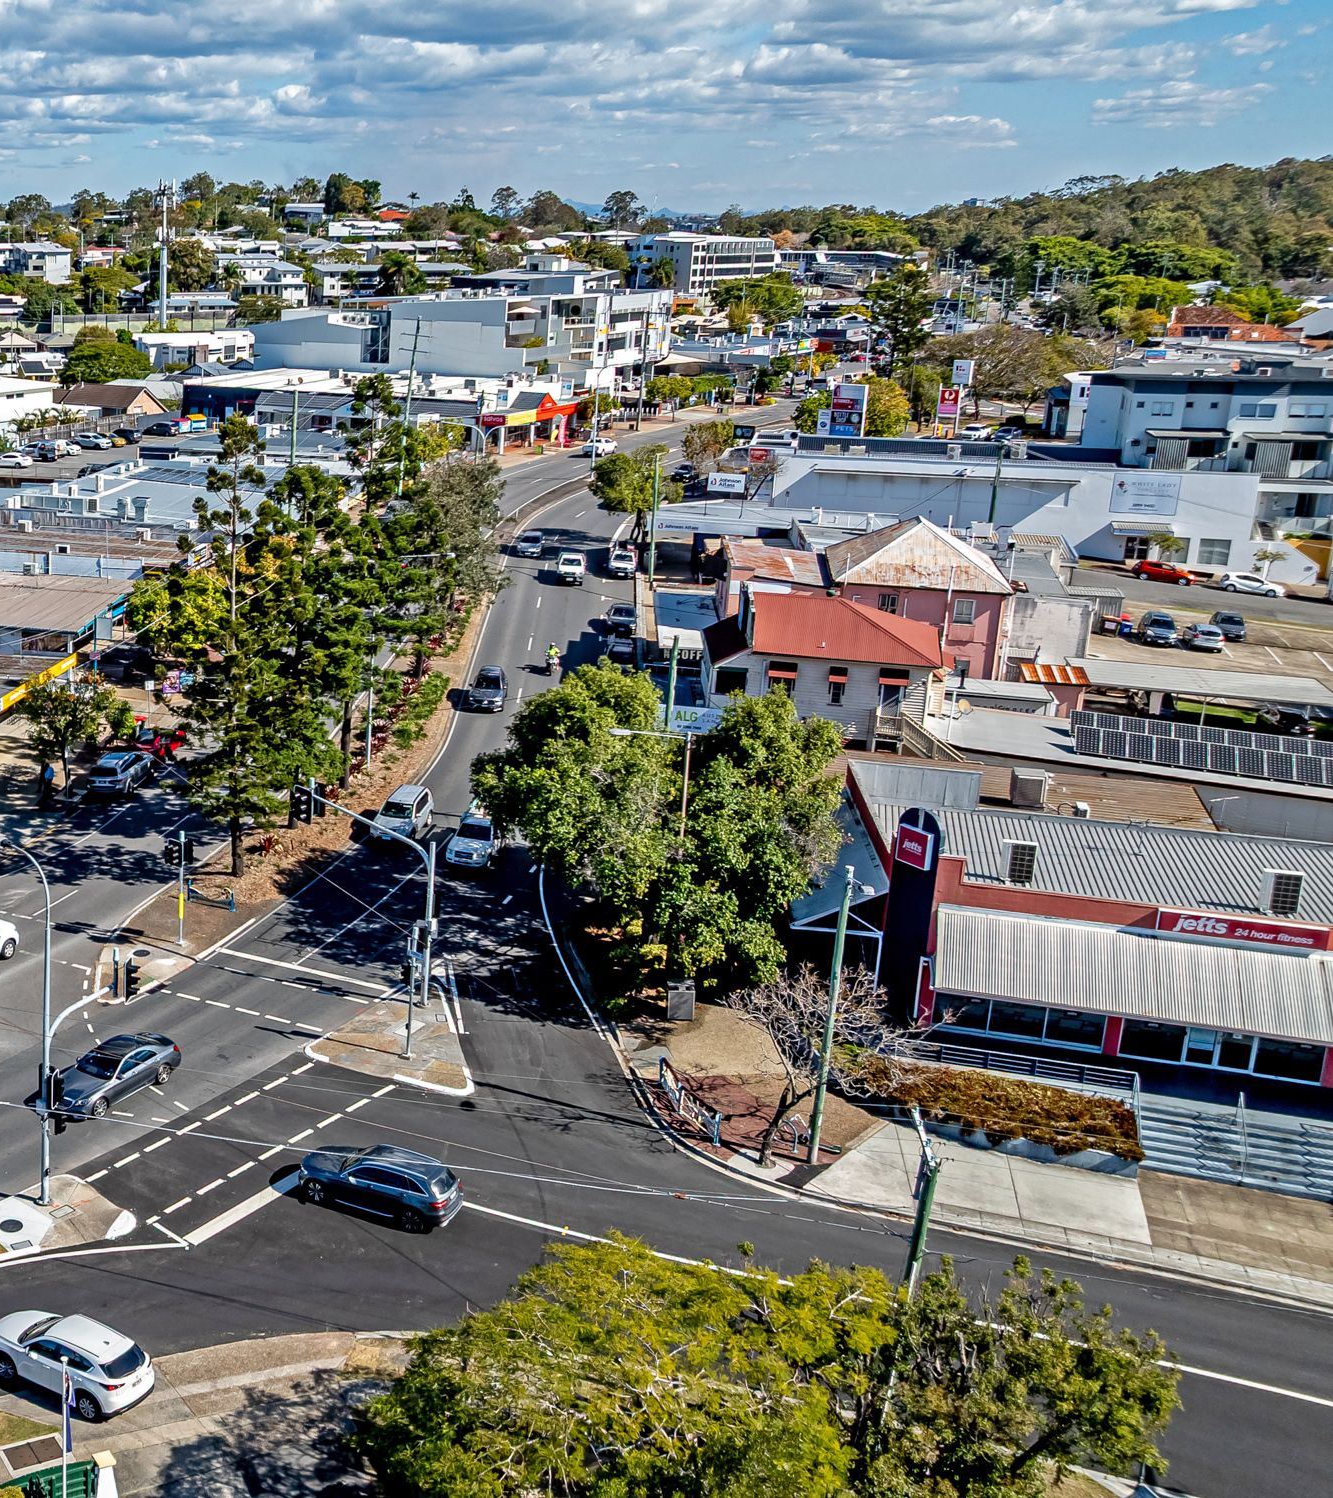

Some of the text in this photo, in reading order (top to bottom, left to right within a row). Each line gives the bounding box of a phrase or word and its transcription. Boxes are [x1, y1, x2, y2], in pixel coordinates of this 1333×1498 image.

[674, 710, 698, 723] ALG
[902, 838, 923, 853] jetts
[1172, 914, 1314, 945] jetts 24 hour fitness
